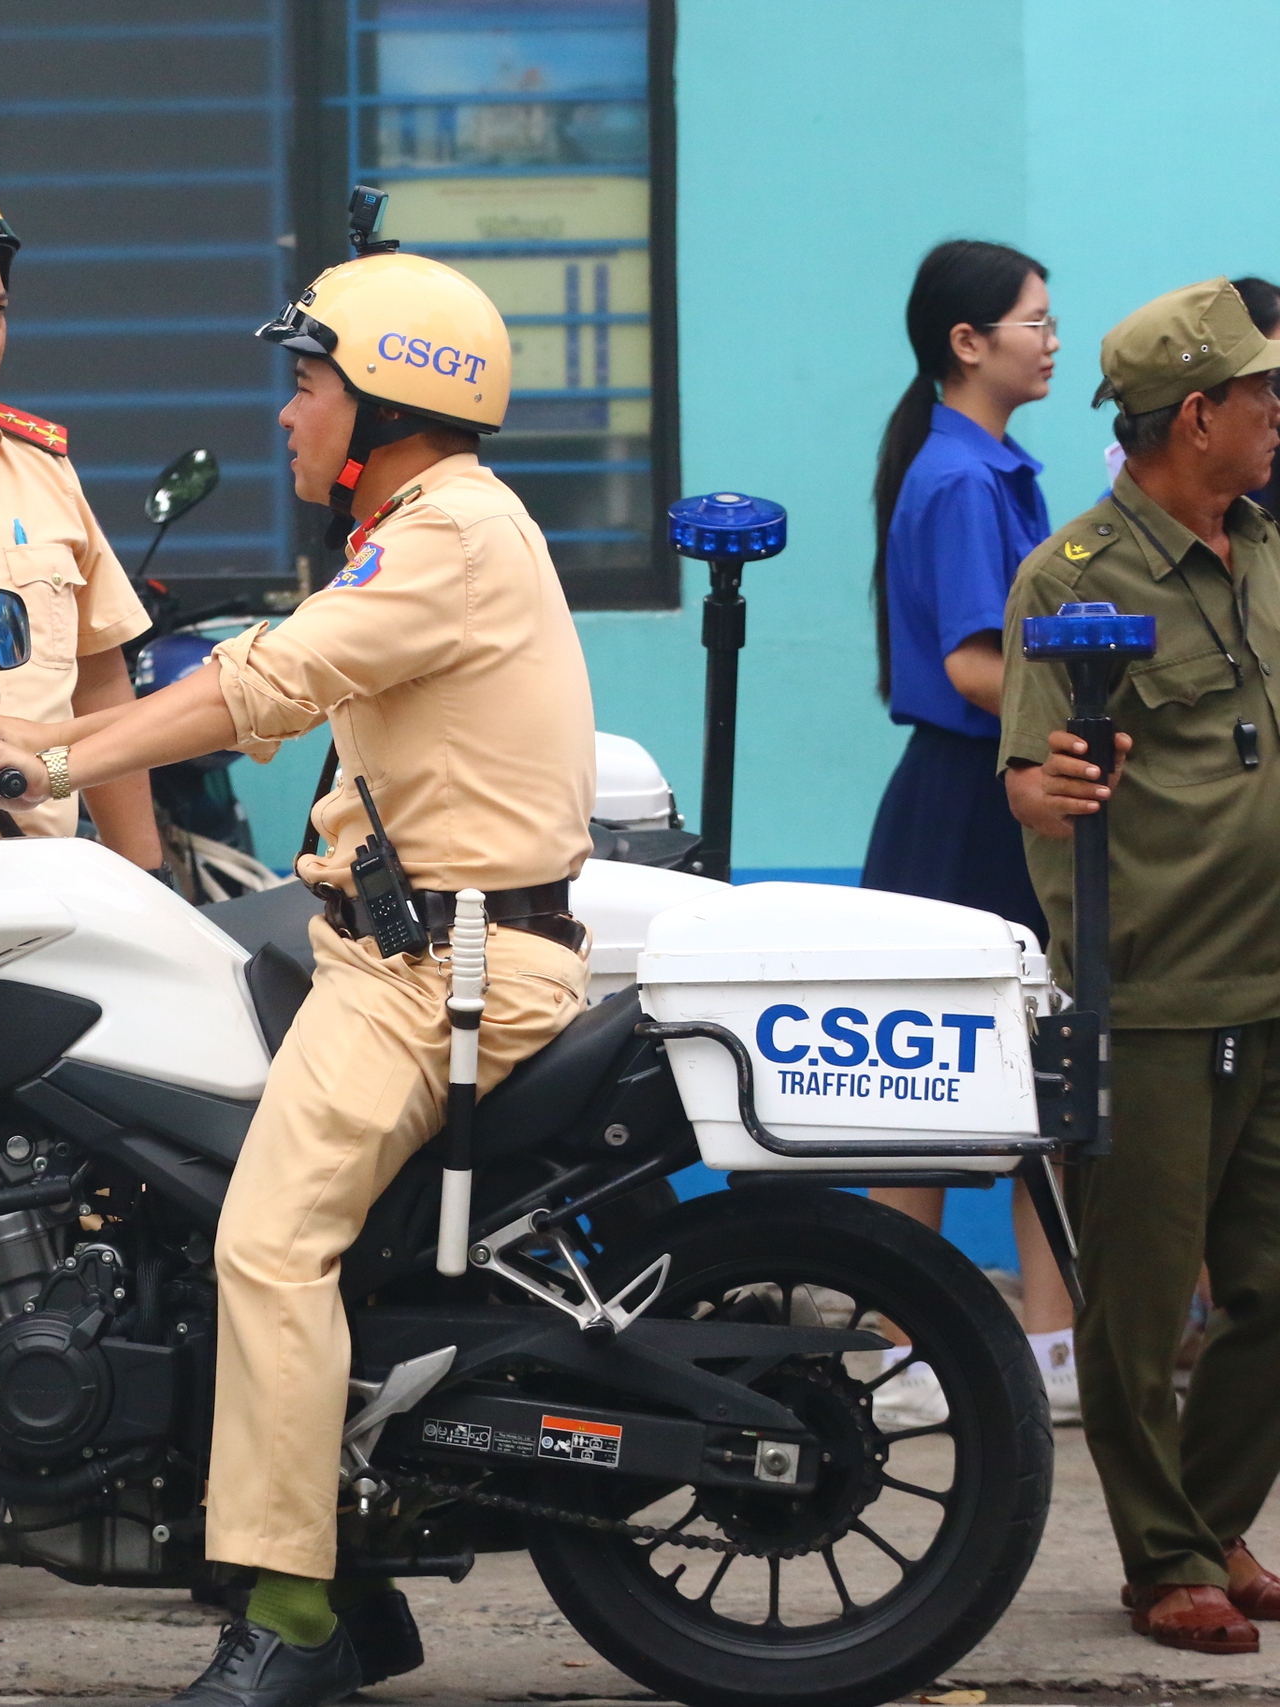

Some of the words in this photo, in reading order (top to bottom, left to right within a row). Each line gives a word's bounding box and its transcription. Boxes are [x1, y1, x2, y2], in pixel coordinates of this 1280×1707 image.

[378, 332, 486, 385] CSGT
[755, 1003, 995, 1073] C.S.G.T
[777, 1070, 870, 1098] TRAFFIC
[880, 1075, 960, 1102] POLICE
